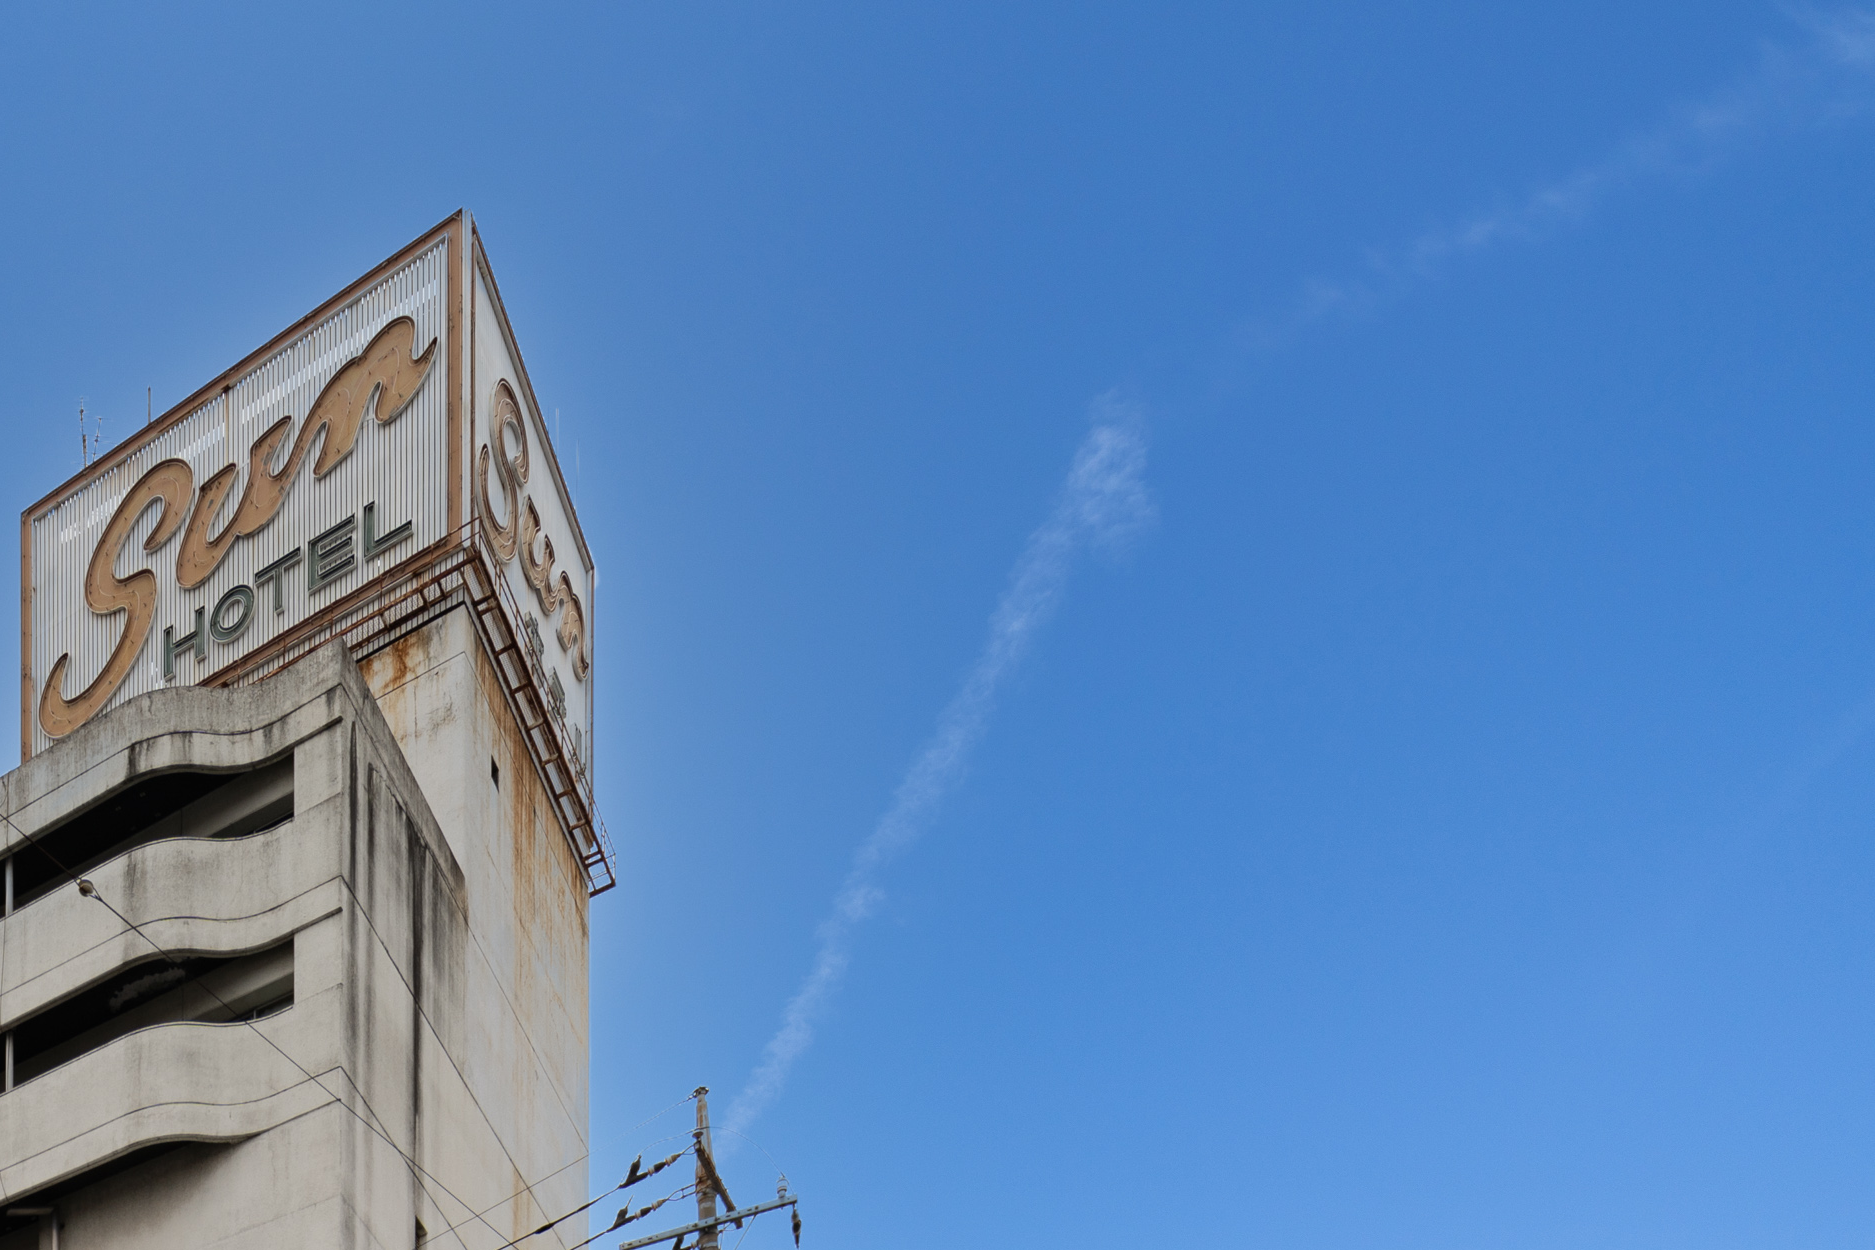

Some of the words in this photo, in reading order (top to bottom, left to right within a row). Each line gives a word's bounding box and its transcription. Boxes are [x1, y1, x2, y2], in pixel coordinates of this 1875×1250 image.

[39, 315, 438, 739] Sun
[163, 501, 414, 682] HOTEL
[476, 377, 590, 682] Sun
